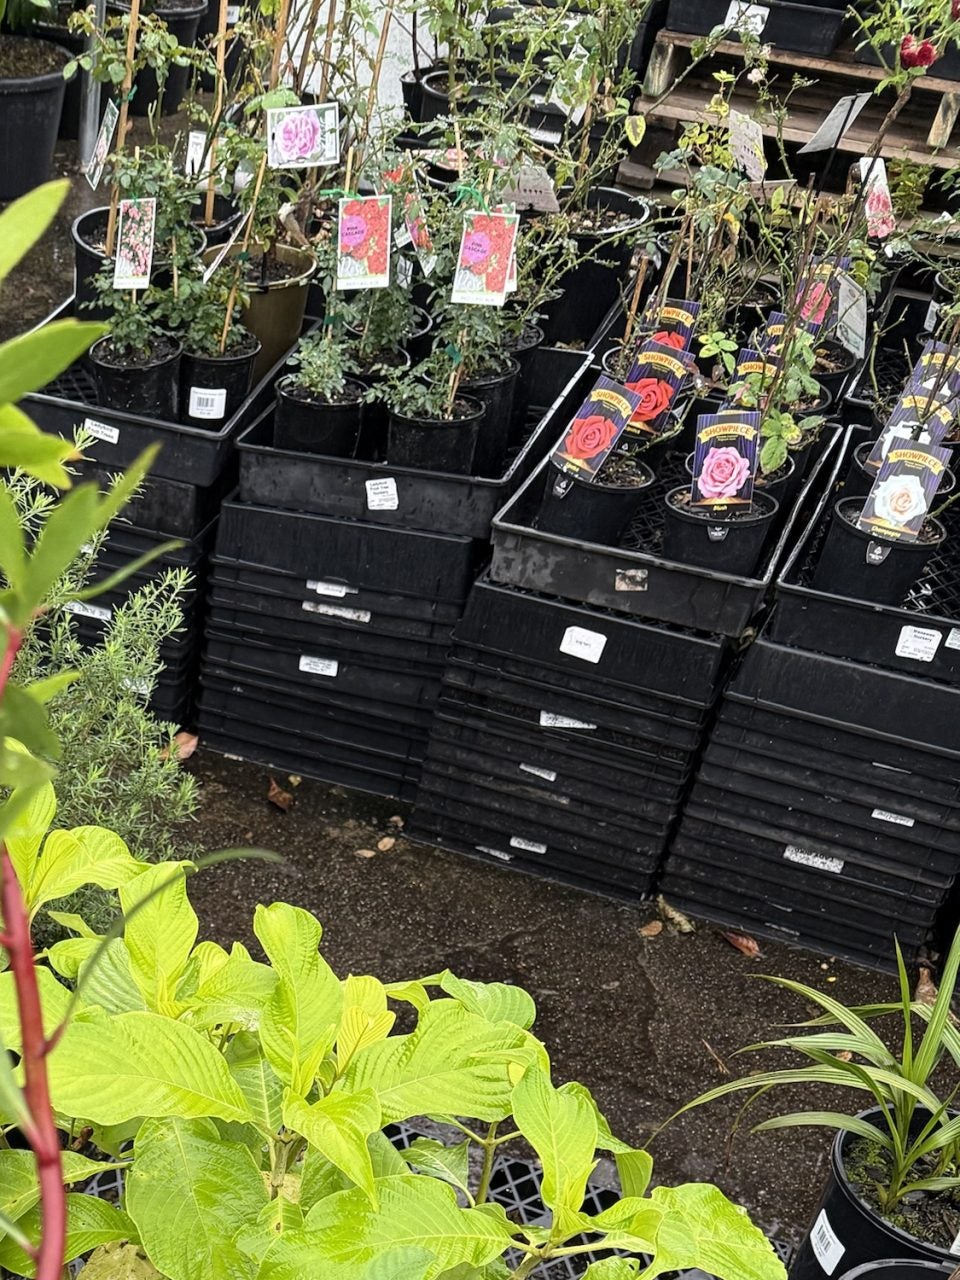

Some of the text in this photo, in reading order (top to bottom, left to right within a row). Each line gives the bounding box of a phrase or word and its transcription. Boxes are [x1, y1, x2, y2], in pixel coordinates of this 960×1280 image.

[643, 353, 682, 373] SHOWPIECE
[704, 425, 751, 438] SHOWPIECE
[894, 451, 938, 468] SHOWPIECE
